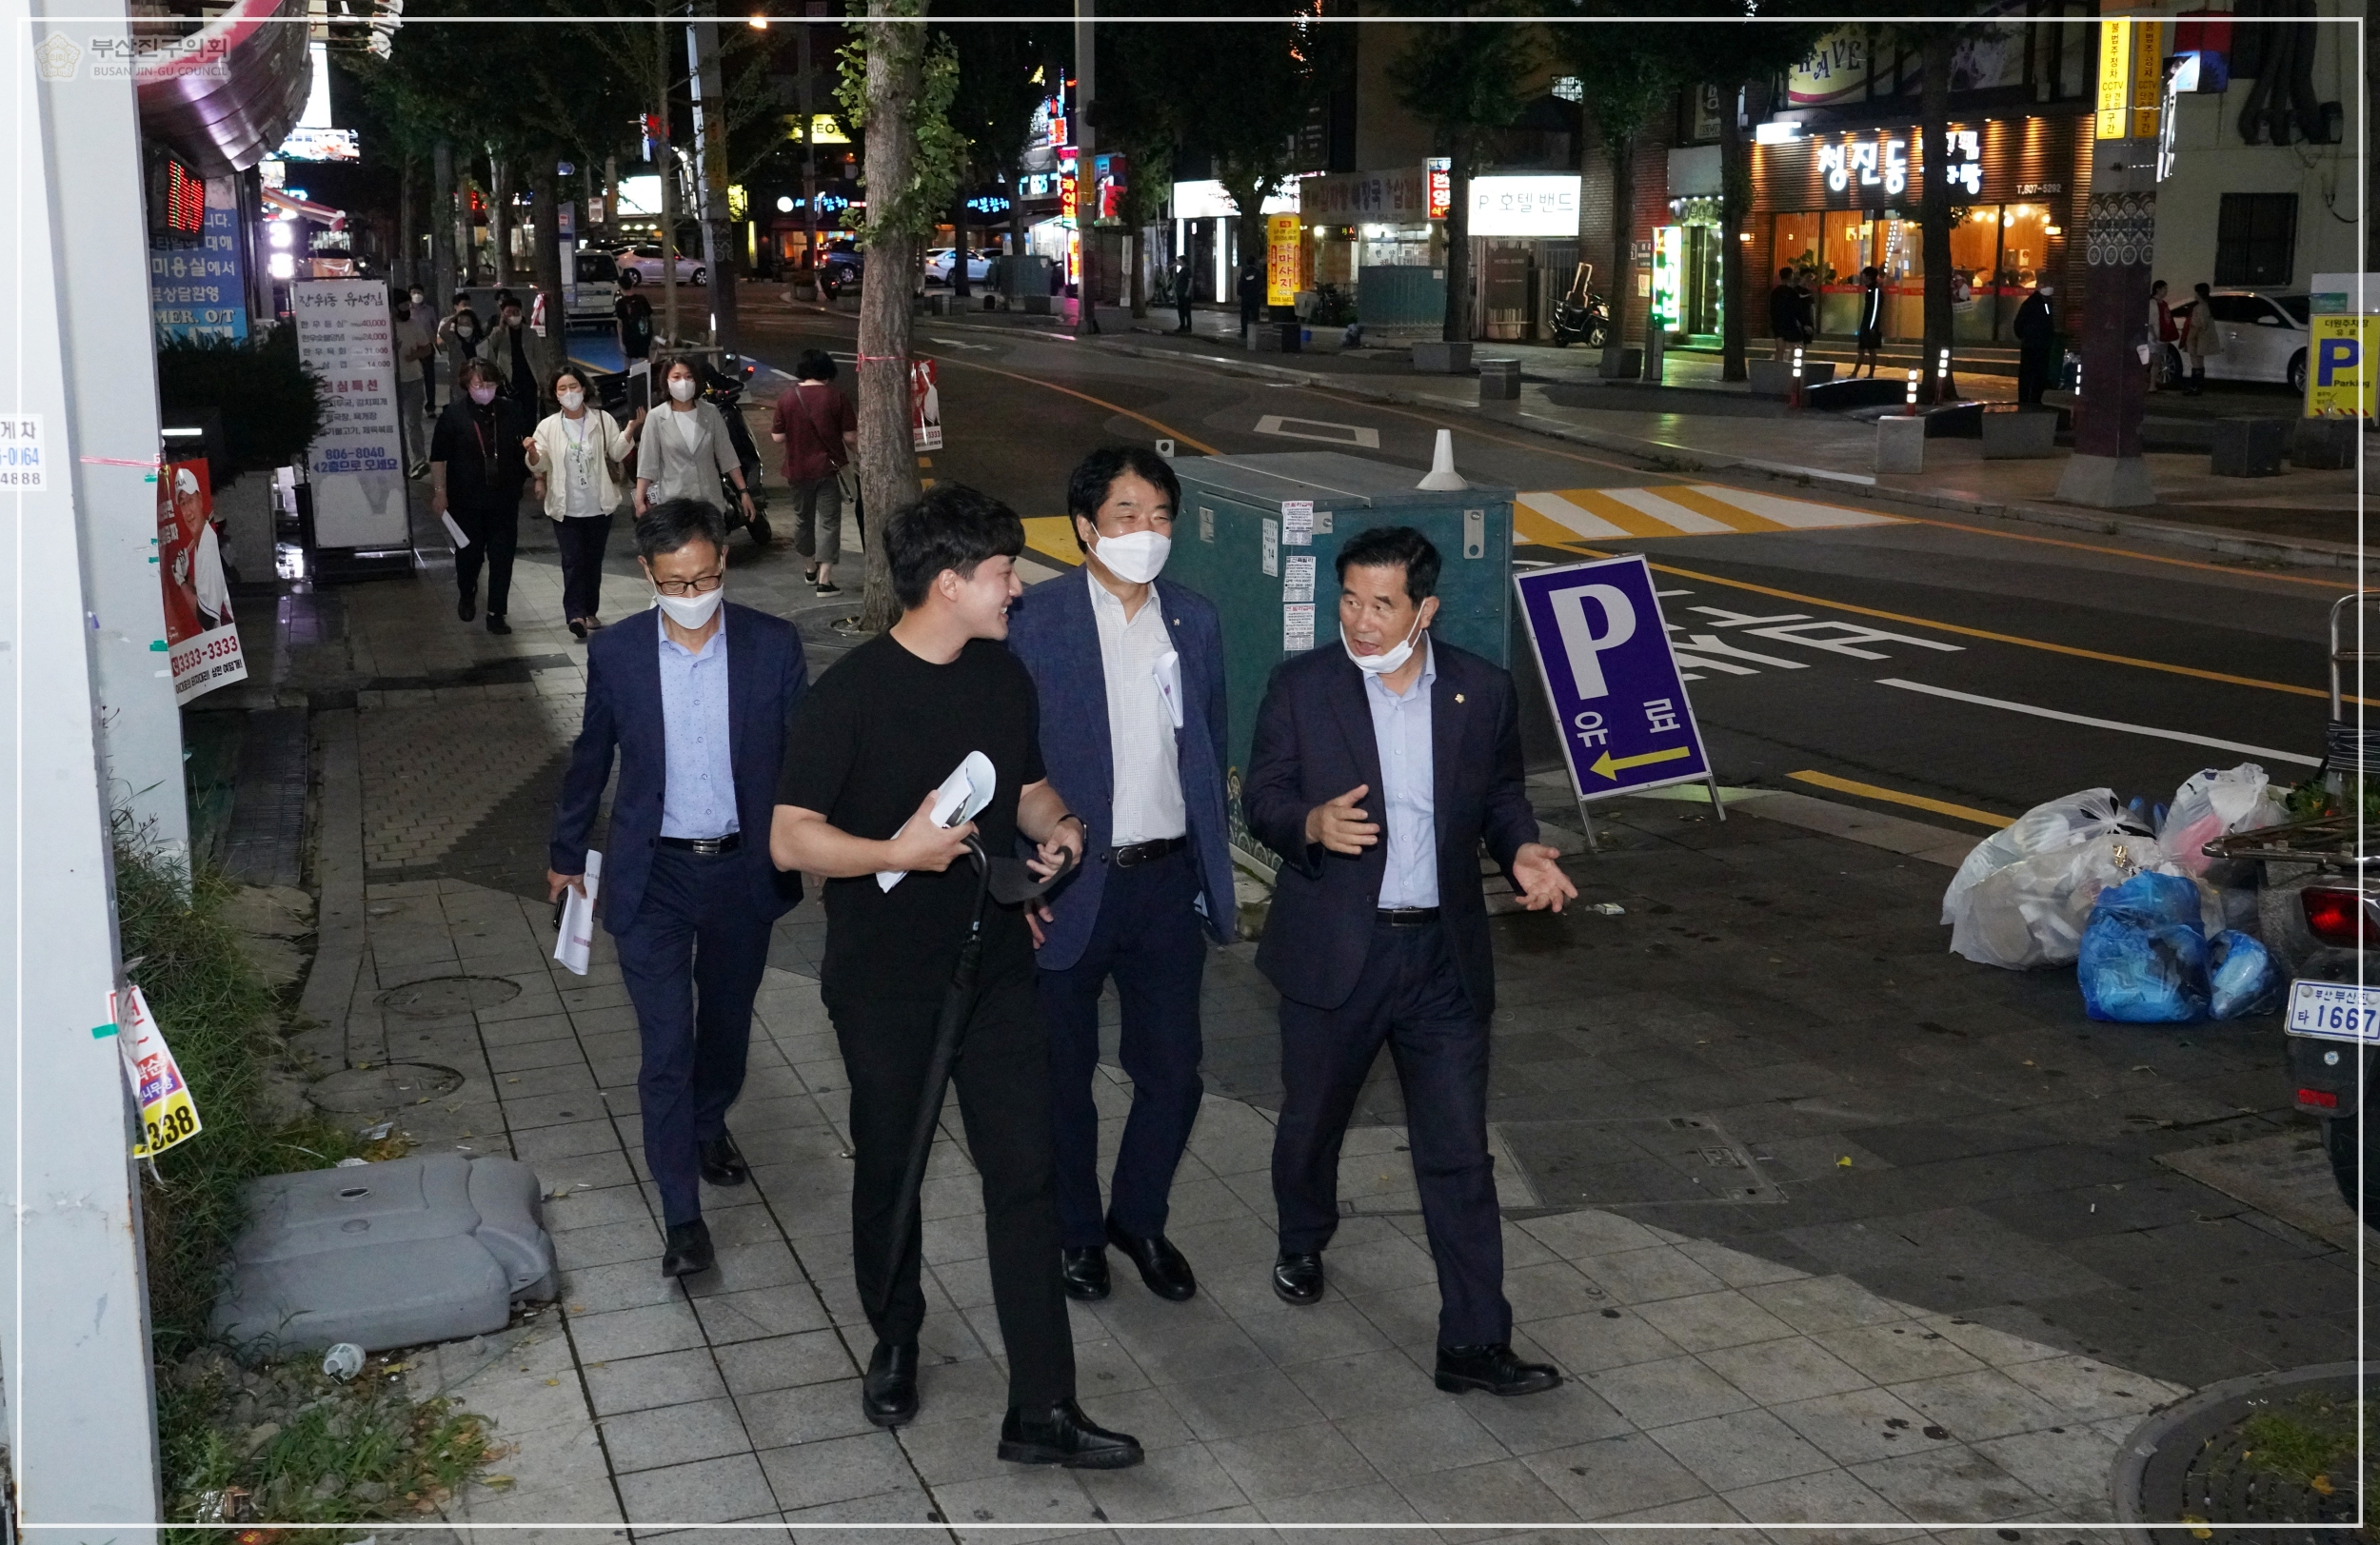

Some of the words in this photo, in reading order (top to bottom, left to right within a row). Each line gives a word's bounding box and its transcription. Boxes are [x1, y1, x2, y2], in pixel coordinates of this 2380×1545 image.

[2110, 23, 2119, 78] 불법주정차
[2102, 82, 2124, 90] CCTV
[2138, 81, 2156, 89] CCTV
[2107, 112, 2115, 134] 구간
[1817, 141, 1905, 195] 청진동
[1478, 195, 1489, 209] P
[205, 235, 233, 251] 대해
[152, 256, 235, 278] 미용실에서
[299, 292, 338, 307] 장위동
[345, 291, 384, 307] 유성집
[205, 309, 235, 325] O/T
[2317, 338, 2365, 386] P
[2333, 379, 2370, 388] Parkig
[0, 447, 39, 465] -0064
[326, 446, 386, 460] 806-8040
[321, 459, 362, 473] 2층으로
[365, 458, 398, 471] 오세요
[1548, 584, 1636, 701] P
[179, 635, 238, 672] 3333-3333
[2315, 990, 2332, 1001] 부산
[2297, 1009, 2310, 1025] 타
[2317, 1004, 2376, 1032] 1667
